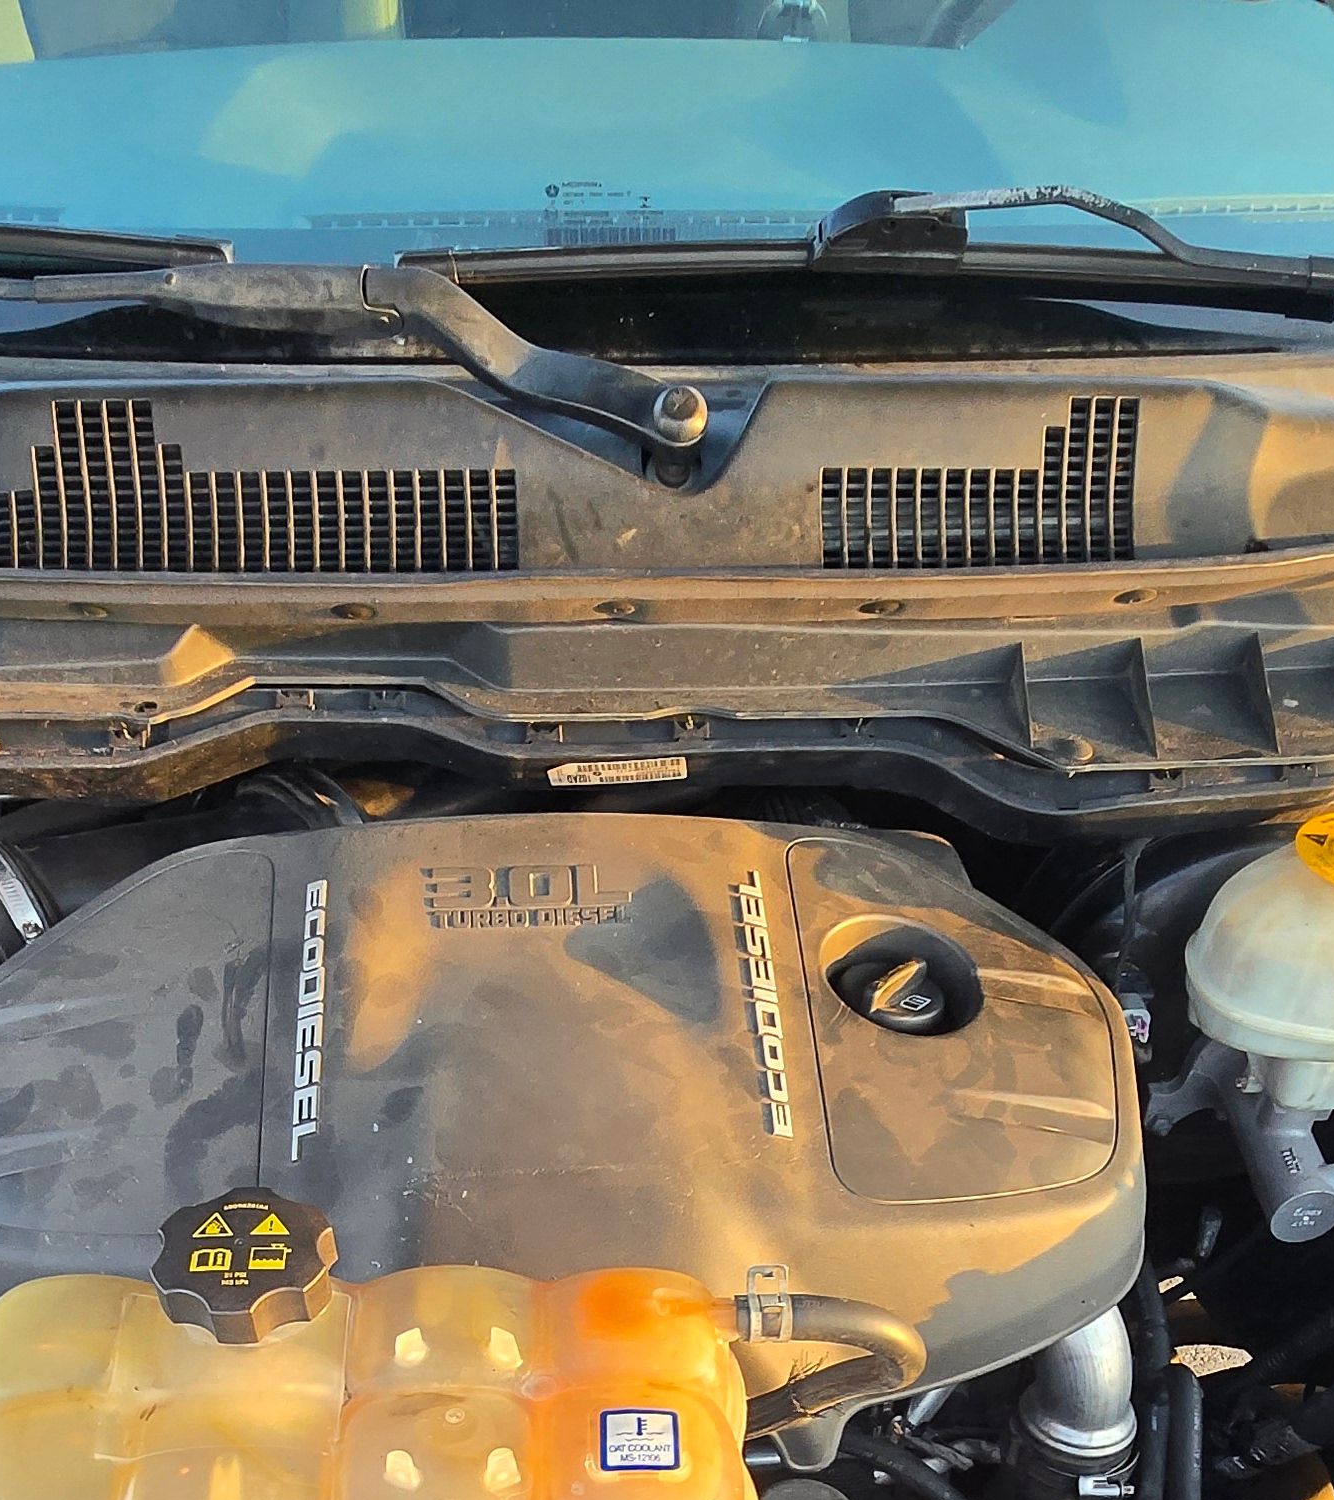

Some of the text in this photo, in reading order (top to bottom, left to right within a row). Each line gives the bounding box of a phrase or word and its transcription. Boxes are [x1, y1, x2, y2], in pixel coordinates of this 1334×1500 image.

[428, 904, 633, 928] TURBO DIESEL
[291, 879, 328, 1162] ECODIESEL
[737, 869, 794, 1139] ECODIESEL
[608, 1443, 672, 1453] OAT COOLANT
